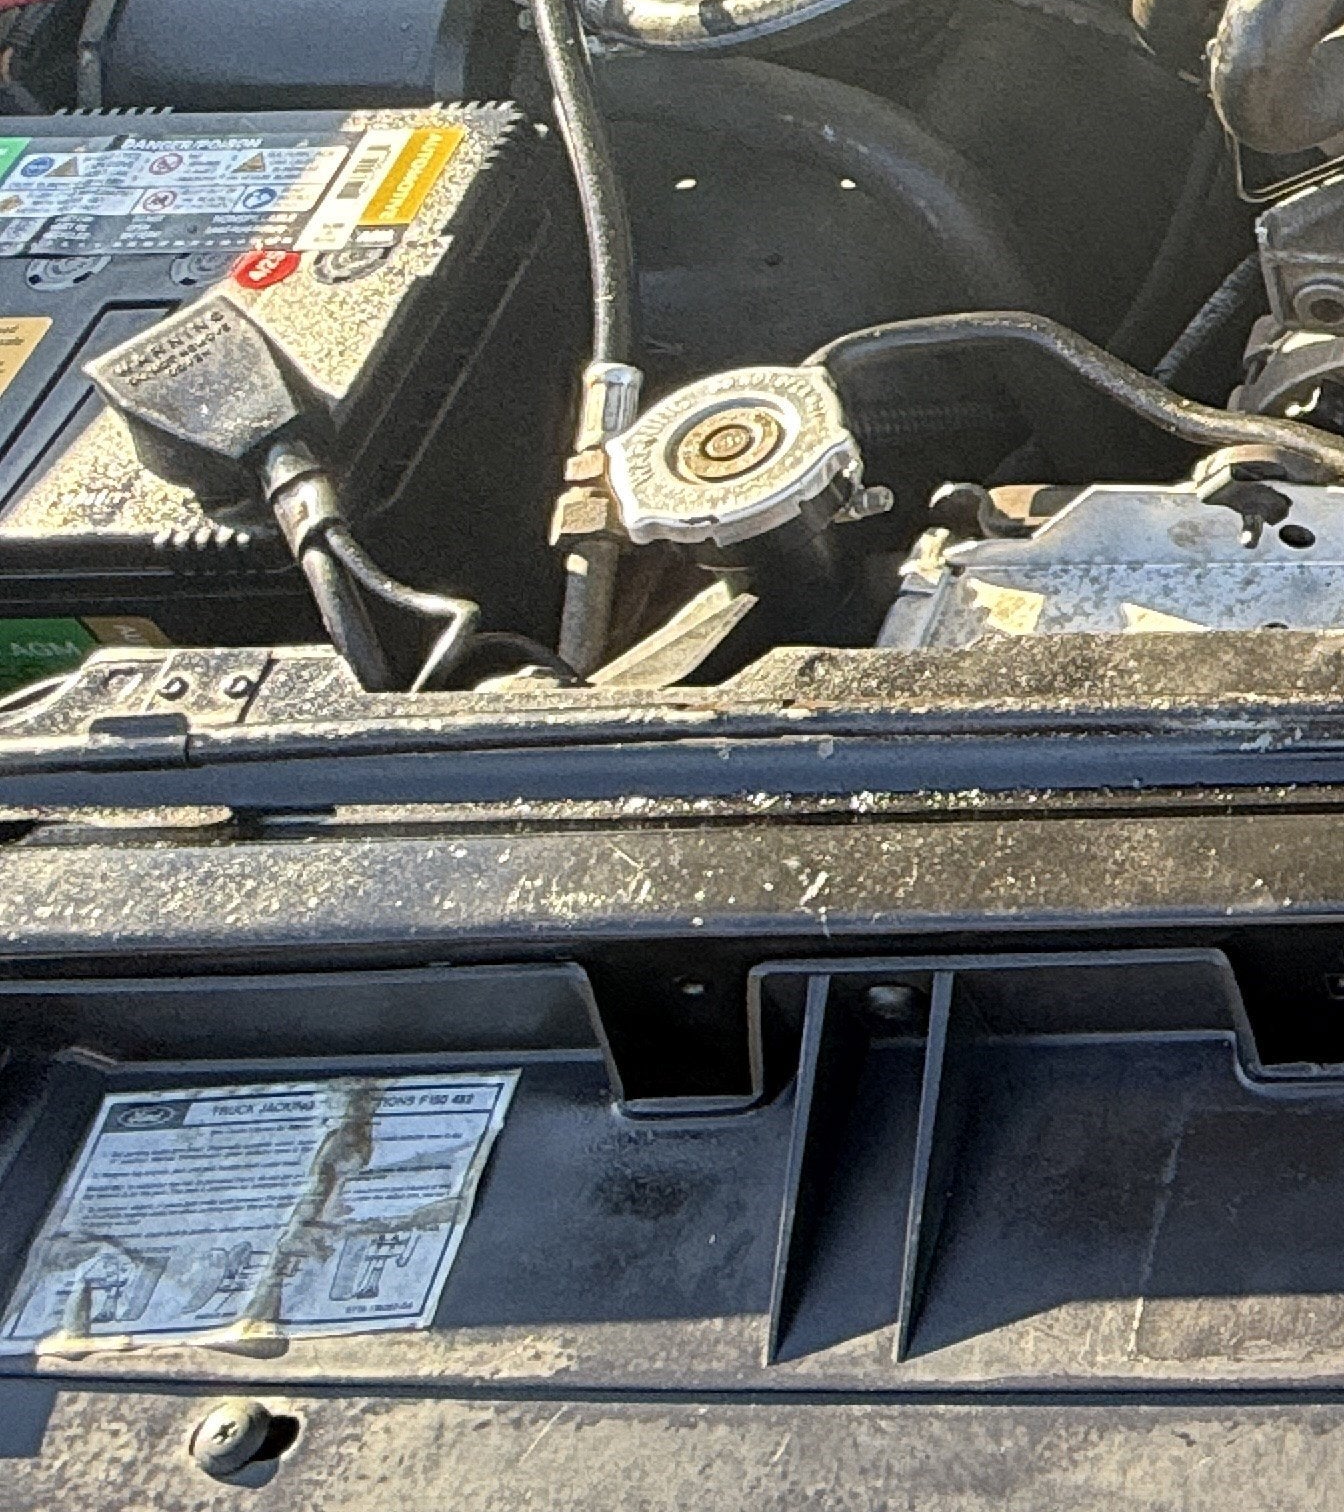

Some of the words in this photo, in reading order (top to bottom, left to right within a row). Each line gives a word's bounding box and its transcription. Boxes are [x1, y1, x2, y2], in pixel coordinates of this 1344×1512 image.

[381, 133, 443, 220] AUTOMOTIVE
[213, 1104, 254, 1116] TRUCK
[259, 1100, 315, 1114] JACKING
